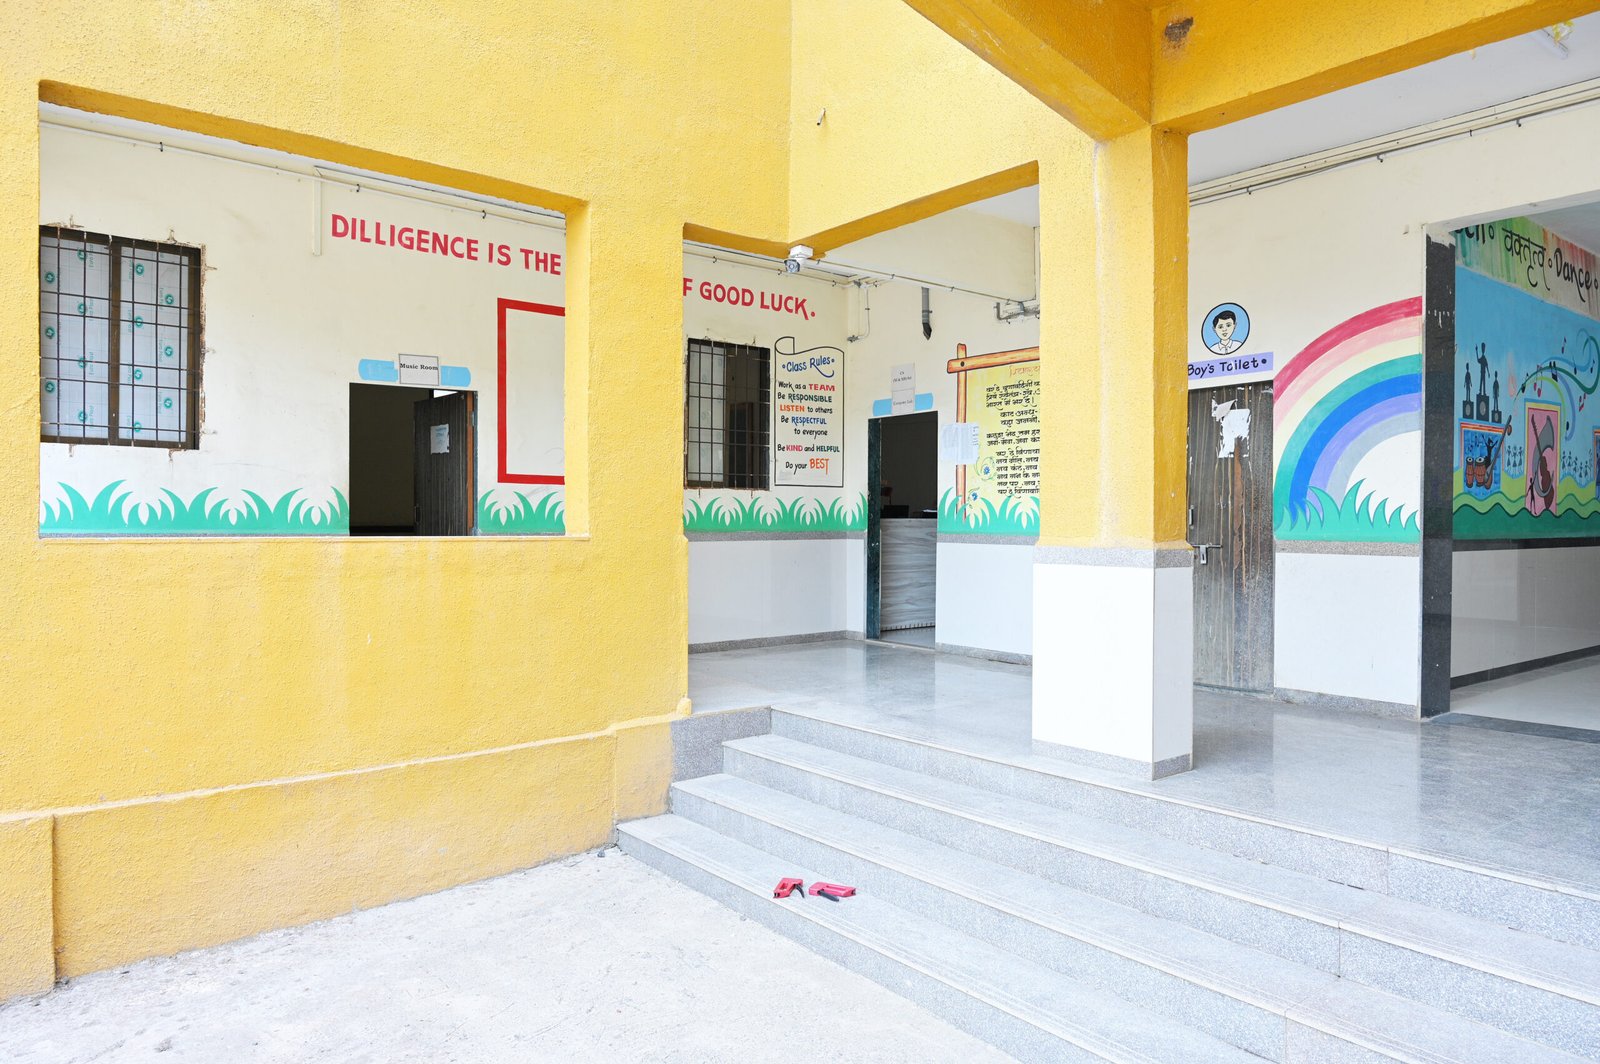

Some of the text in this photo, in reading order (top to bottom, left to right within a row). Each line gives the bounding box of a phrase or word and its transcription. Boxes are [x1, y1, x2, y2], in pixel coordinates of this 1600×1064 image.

[331, 213, 816, 321] DILLIGENCE IS THE F GOOD LUCK.
[1554, 247, 1592, 302] Dance
[786, 355, 835, 378] Class Rules
[1187, 357, 1259, 379] Boy's Toilet
[778, 381, 795, 392] Work
[808, 383, 836, 392] TEAM
[777, 391, 833, 403] Be RESPONSIBLE
[779, 404, 805, 412] LISTEN
[815, 406, 833, 414] others
[780, 415, 827, 426] Be RESPECTFUL
[802, 429, 828, 440] everyone
[777, 443, 840, 453] Be KIND and HELPFUL
[785, 458, 830, 475] Do your BEST
